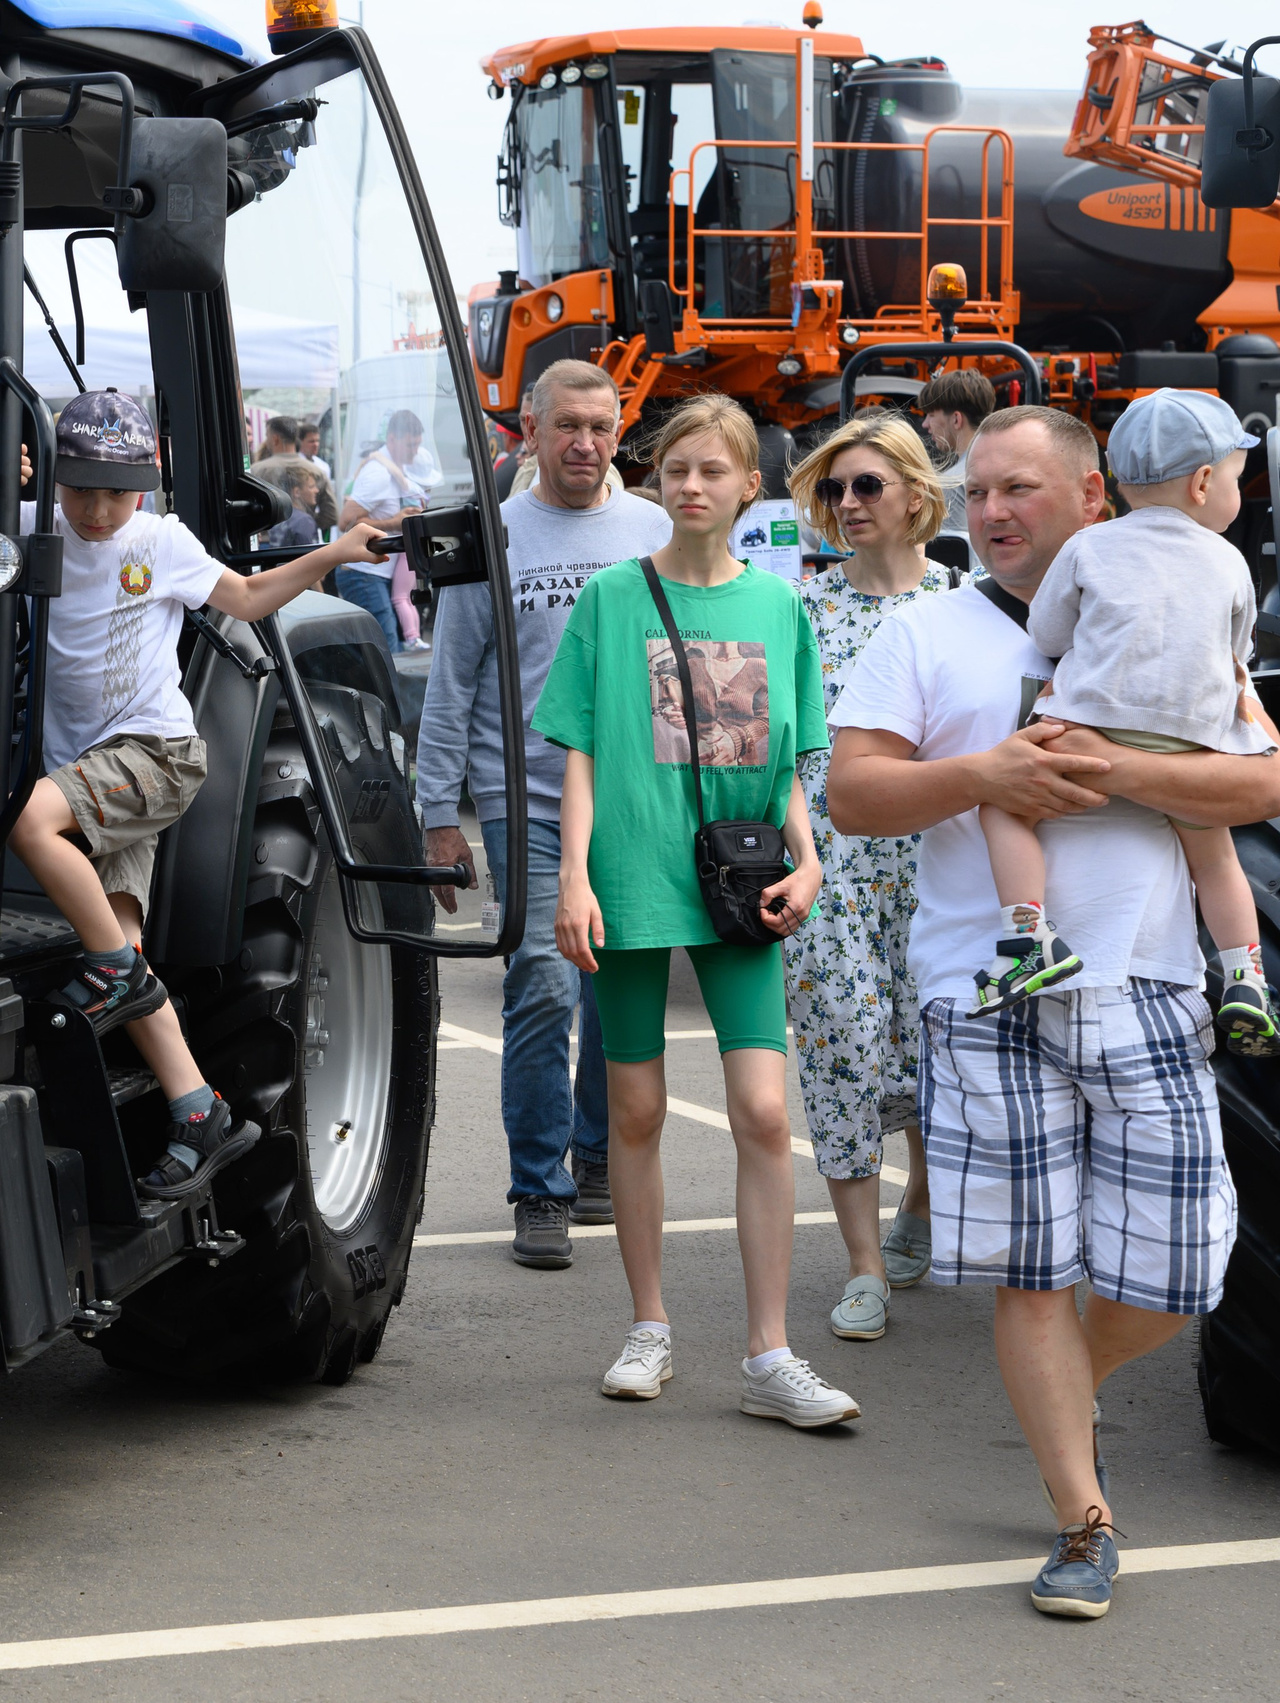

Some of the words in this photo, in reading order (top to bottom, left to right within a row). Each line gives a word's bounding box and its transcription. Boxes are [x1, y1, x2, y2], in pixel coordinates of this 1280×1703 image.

[1107, 192, 1162, 208] Uniport
[1122, 207, 1162, 219] 4530
[122, 431, 147, 447] AREA
[518, 563, 563, 577] Никакой
[567, 560, 622, 572] чрезвыч
[520, 576, 591, 595] РАЗДЕ
[520, 597, 535, 614] И
[645, 629, 712, 639] CALORNIA
